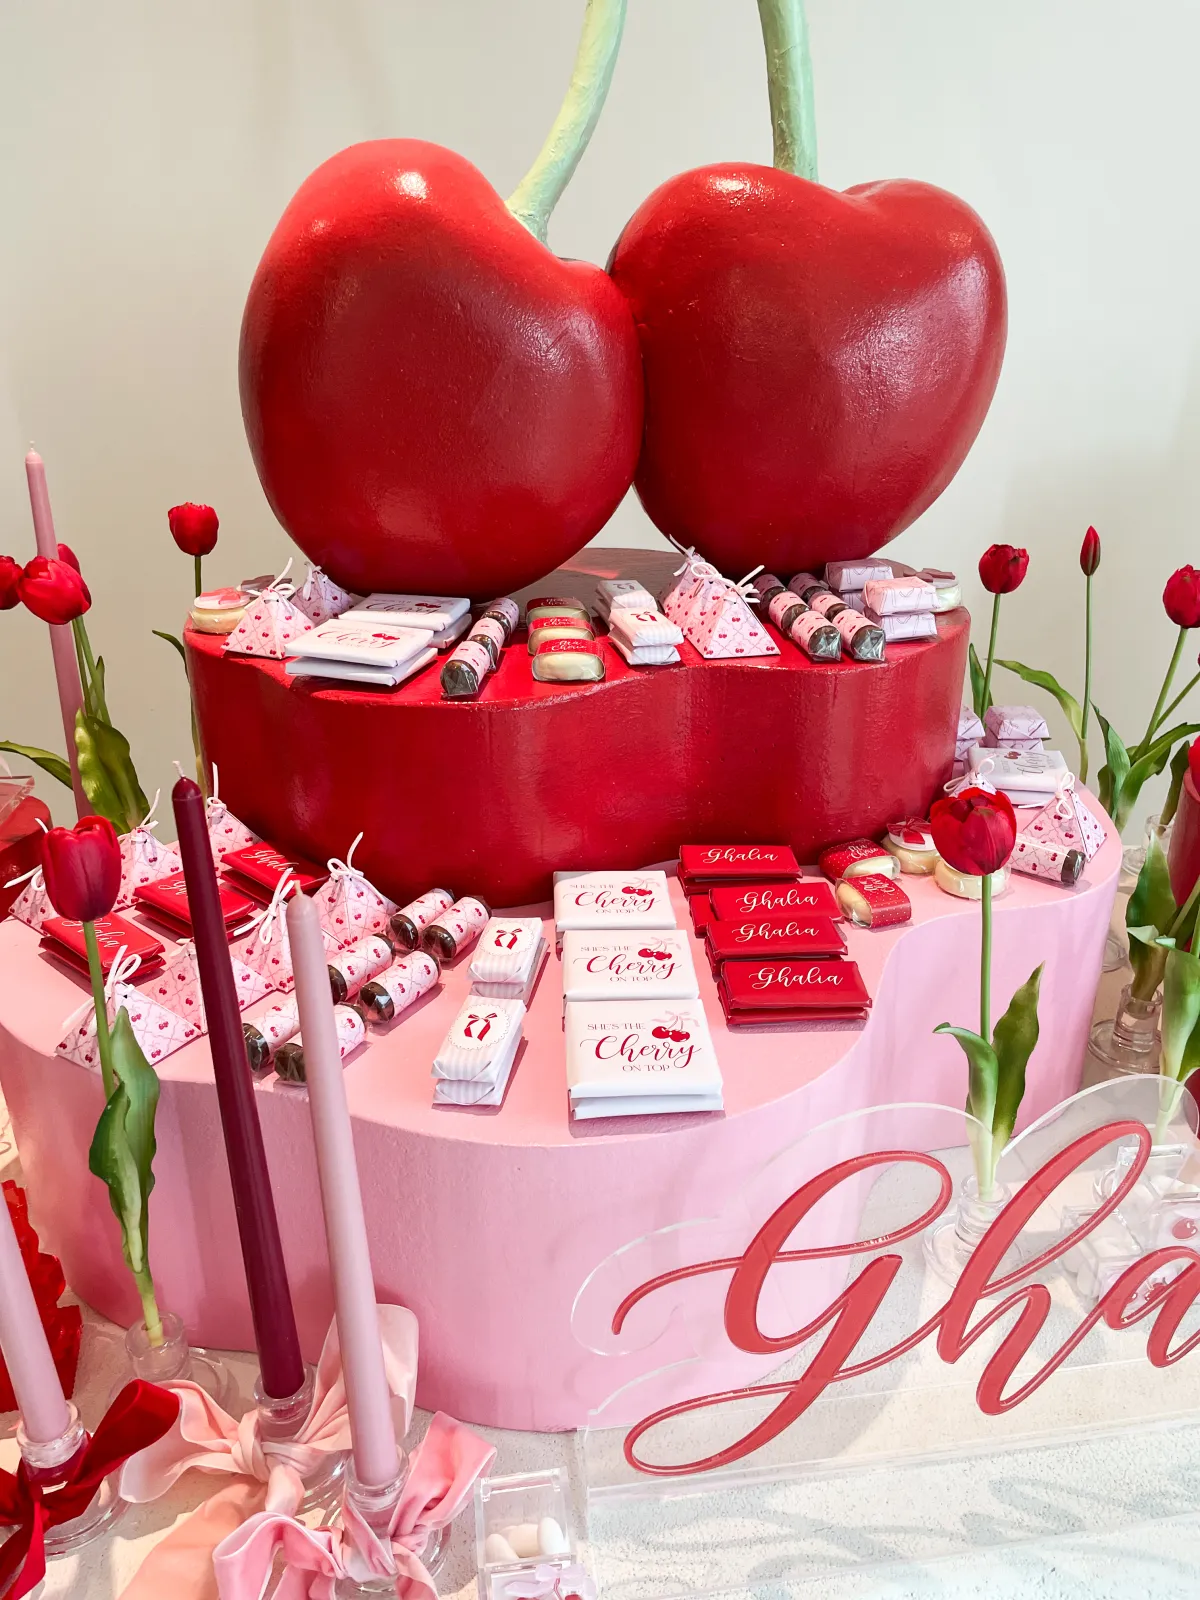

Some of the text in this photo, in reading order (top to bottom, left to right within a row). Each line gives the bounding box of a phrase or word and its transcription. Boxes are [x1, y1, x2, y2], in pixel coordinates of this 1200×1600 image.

[700, 848, 778, 864] Ghalia
[563, 891, 661, 912] Cherry
[736, 889, 819, 913] Ghalia
[732, 922, 820, 943] Ghalia
[573, 954, 682, 979] Cherry
[749, 966, 844, 990] Ghalia
[587, 1022, 646, 1031] SHE'S THE
[579, 1033, 702, 1069] Cherry
[622, 1064, 670, 1072] ON TOP
